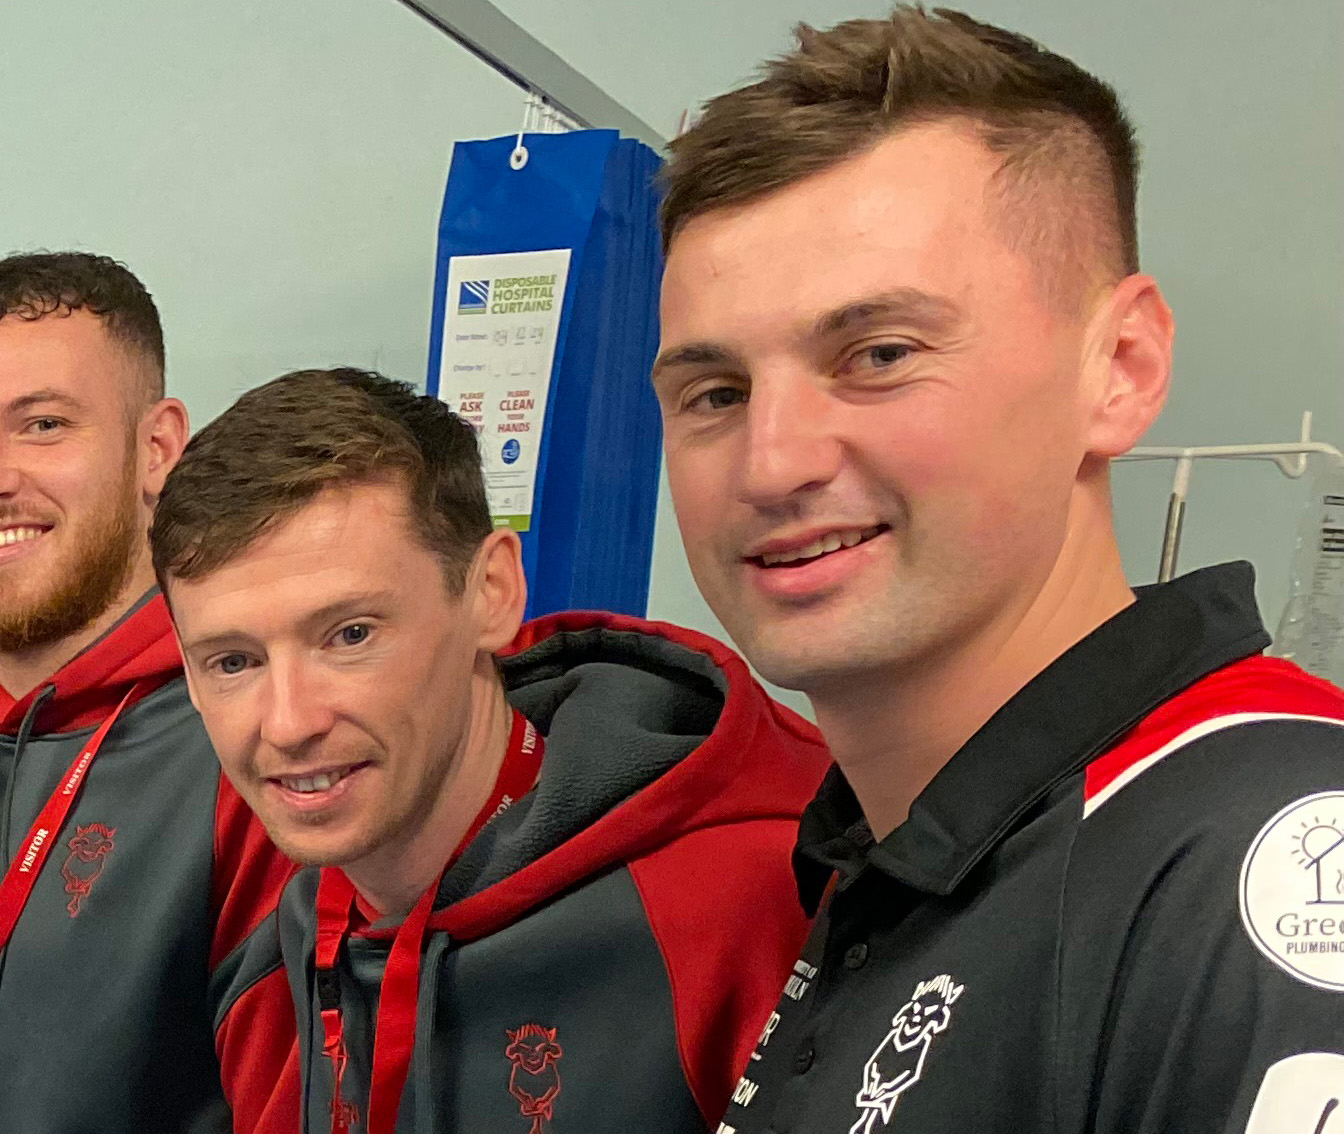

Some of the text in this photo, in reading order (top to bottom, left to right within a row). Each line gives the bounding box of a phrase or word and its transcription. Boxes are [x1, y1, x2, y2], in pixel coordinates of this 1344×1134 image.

[494, 275, 556, 289] DISPOSABLE
[493, 287, 554, 302] HOSPITAL
[491, 300, 553, 315] CURTAINS
[460, 401, 483, 413] ASK
[499, 399, 535, 411] CLEAN
[497, 423, 530, 434] HANDS
[62, 752, 91, 796] VISITOR
[19, 827, 49, 873] VISITOR
